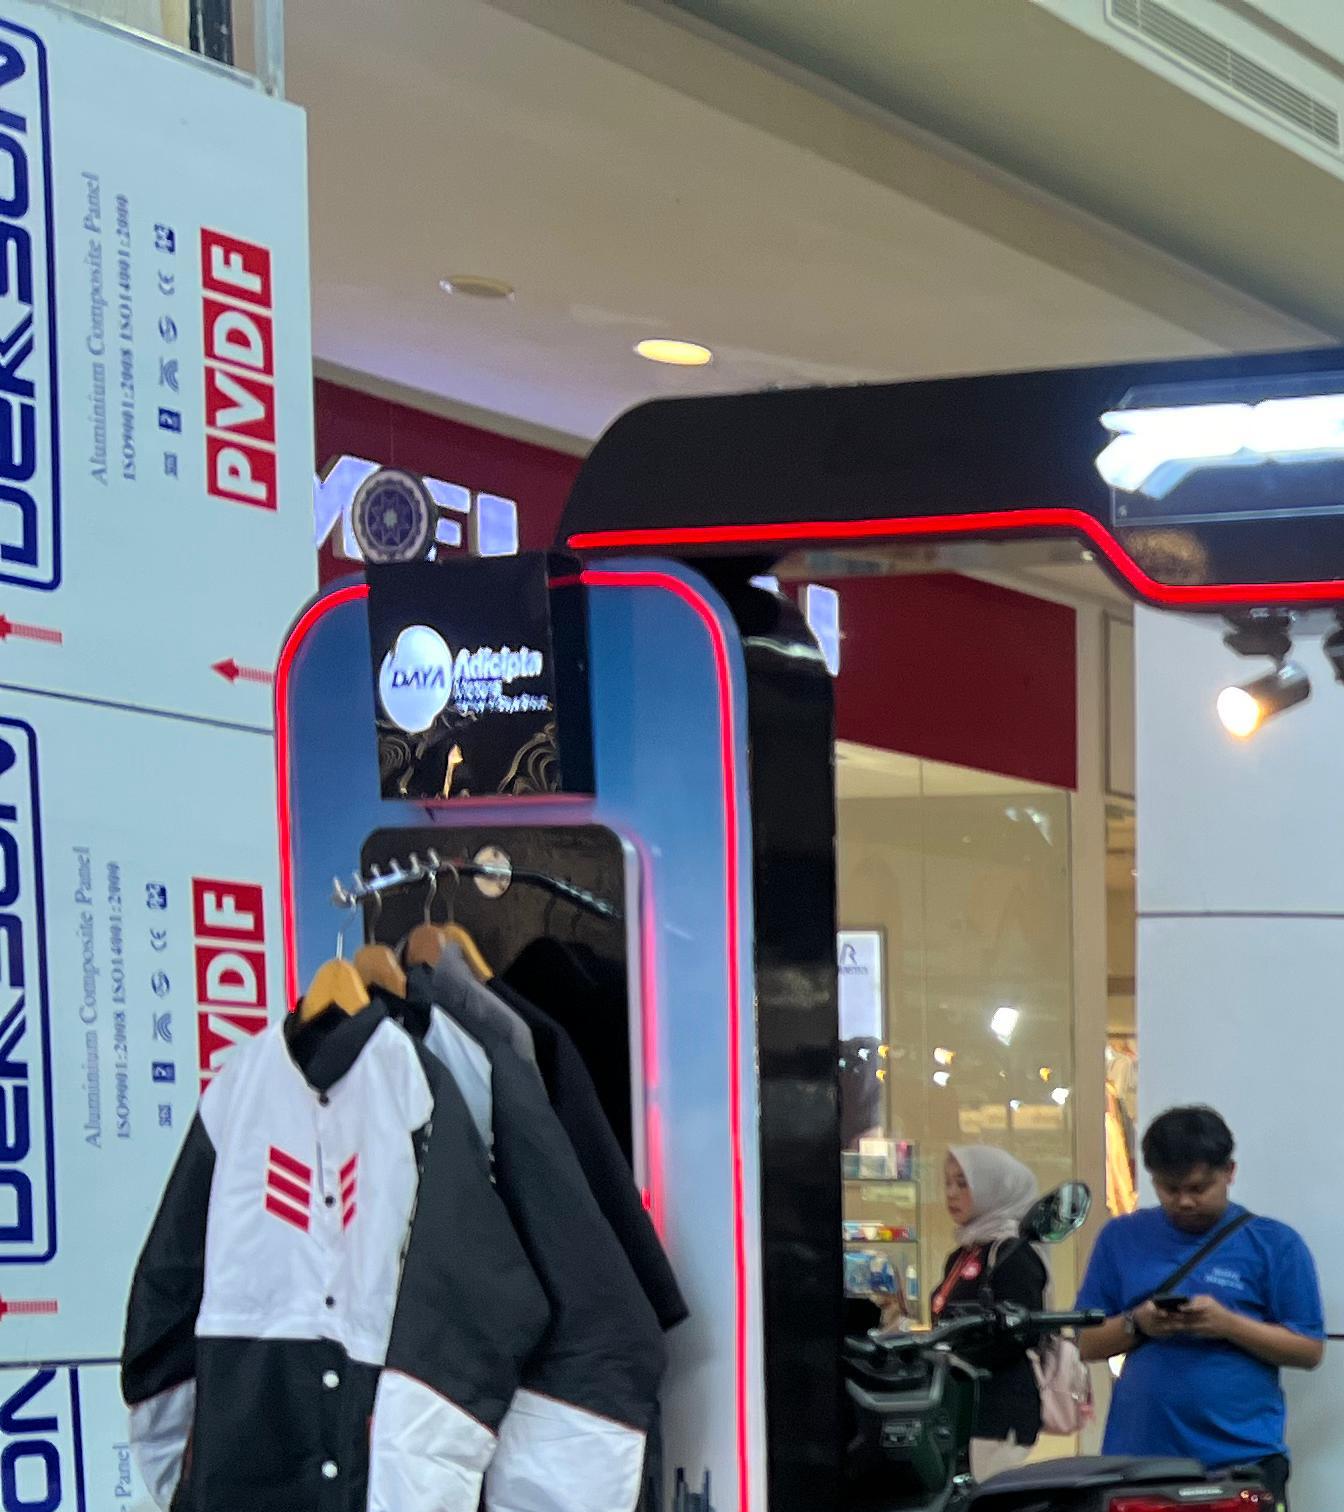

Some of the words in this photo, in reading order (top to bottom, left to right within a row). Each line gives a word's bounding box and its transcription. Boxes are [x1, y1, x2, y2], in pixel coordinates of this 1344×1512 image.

[82, 171, 102, 233] Panel
[83, 239, 108, 355] Composite
[87, 362, 108, 486] Aluminium
[210, 244, 269, 503] PVDF
[72, 846, 93, 906] Panel
[74, 910, 100, 1025] Composite
[203, 890, 258, 1073] VDF
[82, 1029, 102, 1149] Aluminium
[113, 1442, 133, 1498] Panel
